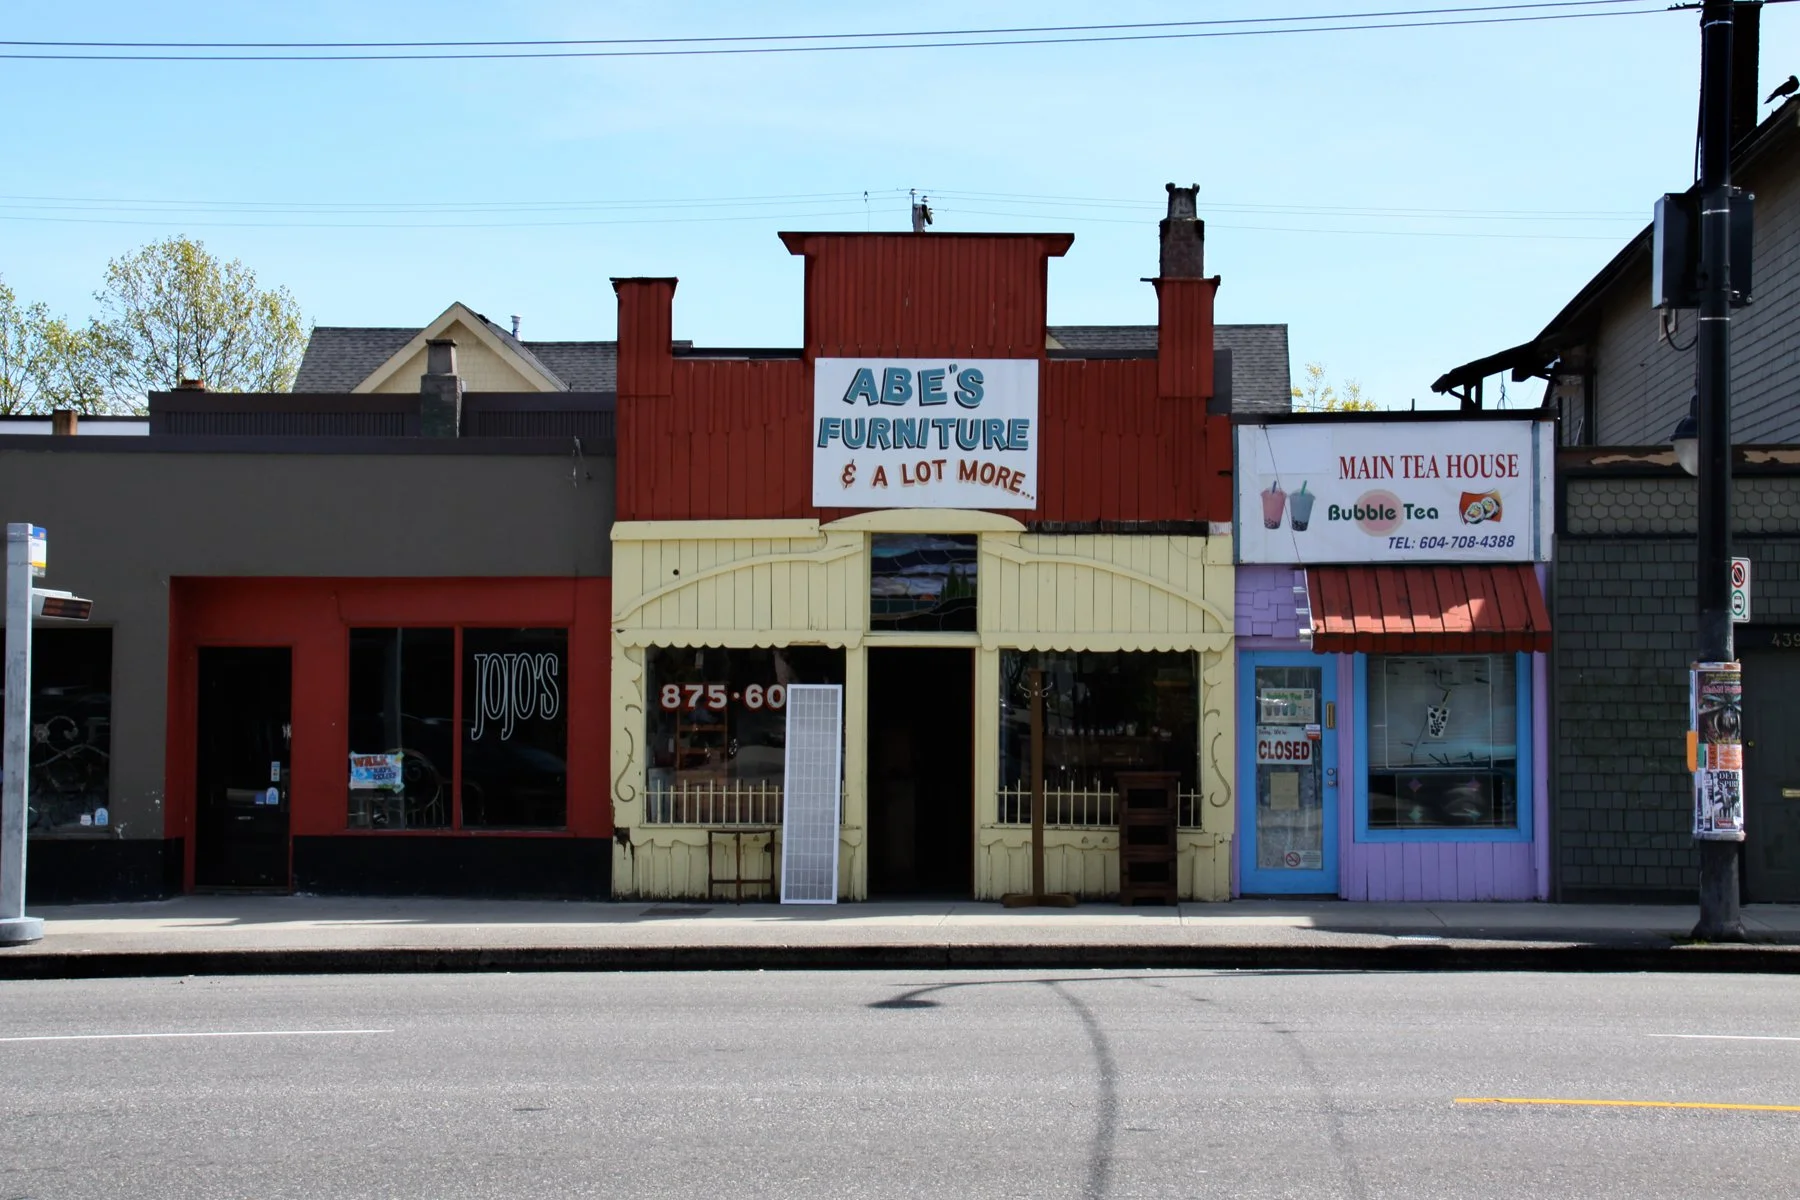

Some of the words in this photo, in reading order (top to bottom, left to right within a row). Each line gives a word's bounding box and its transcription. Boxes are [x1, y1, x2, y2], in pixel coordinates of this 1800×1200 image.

[842, 364, 985, 409] ABE'S
[817, 417, 1030, 452] FURNITURE
[872, 466, 888, 487] A
[901, 459, 947, 485] LOT
[1339, 455, 1394, 480] MAIN
[1400, 454, 1440, 479] TEA
[1446, 453, 1519, 478] HOUSE
[1328, 503, 1396, 521] Bubble
[1403, 503, 1439, 520] Tea
[1388, 537, 1416, 549] TEL:
[1419, 535, 1515, 549] 604-708-4388
[471, 652, 560, 741] JOJO'S
[1258, 740, 1310, 760] CLOSED
